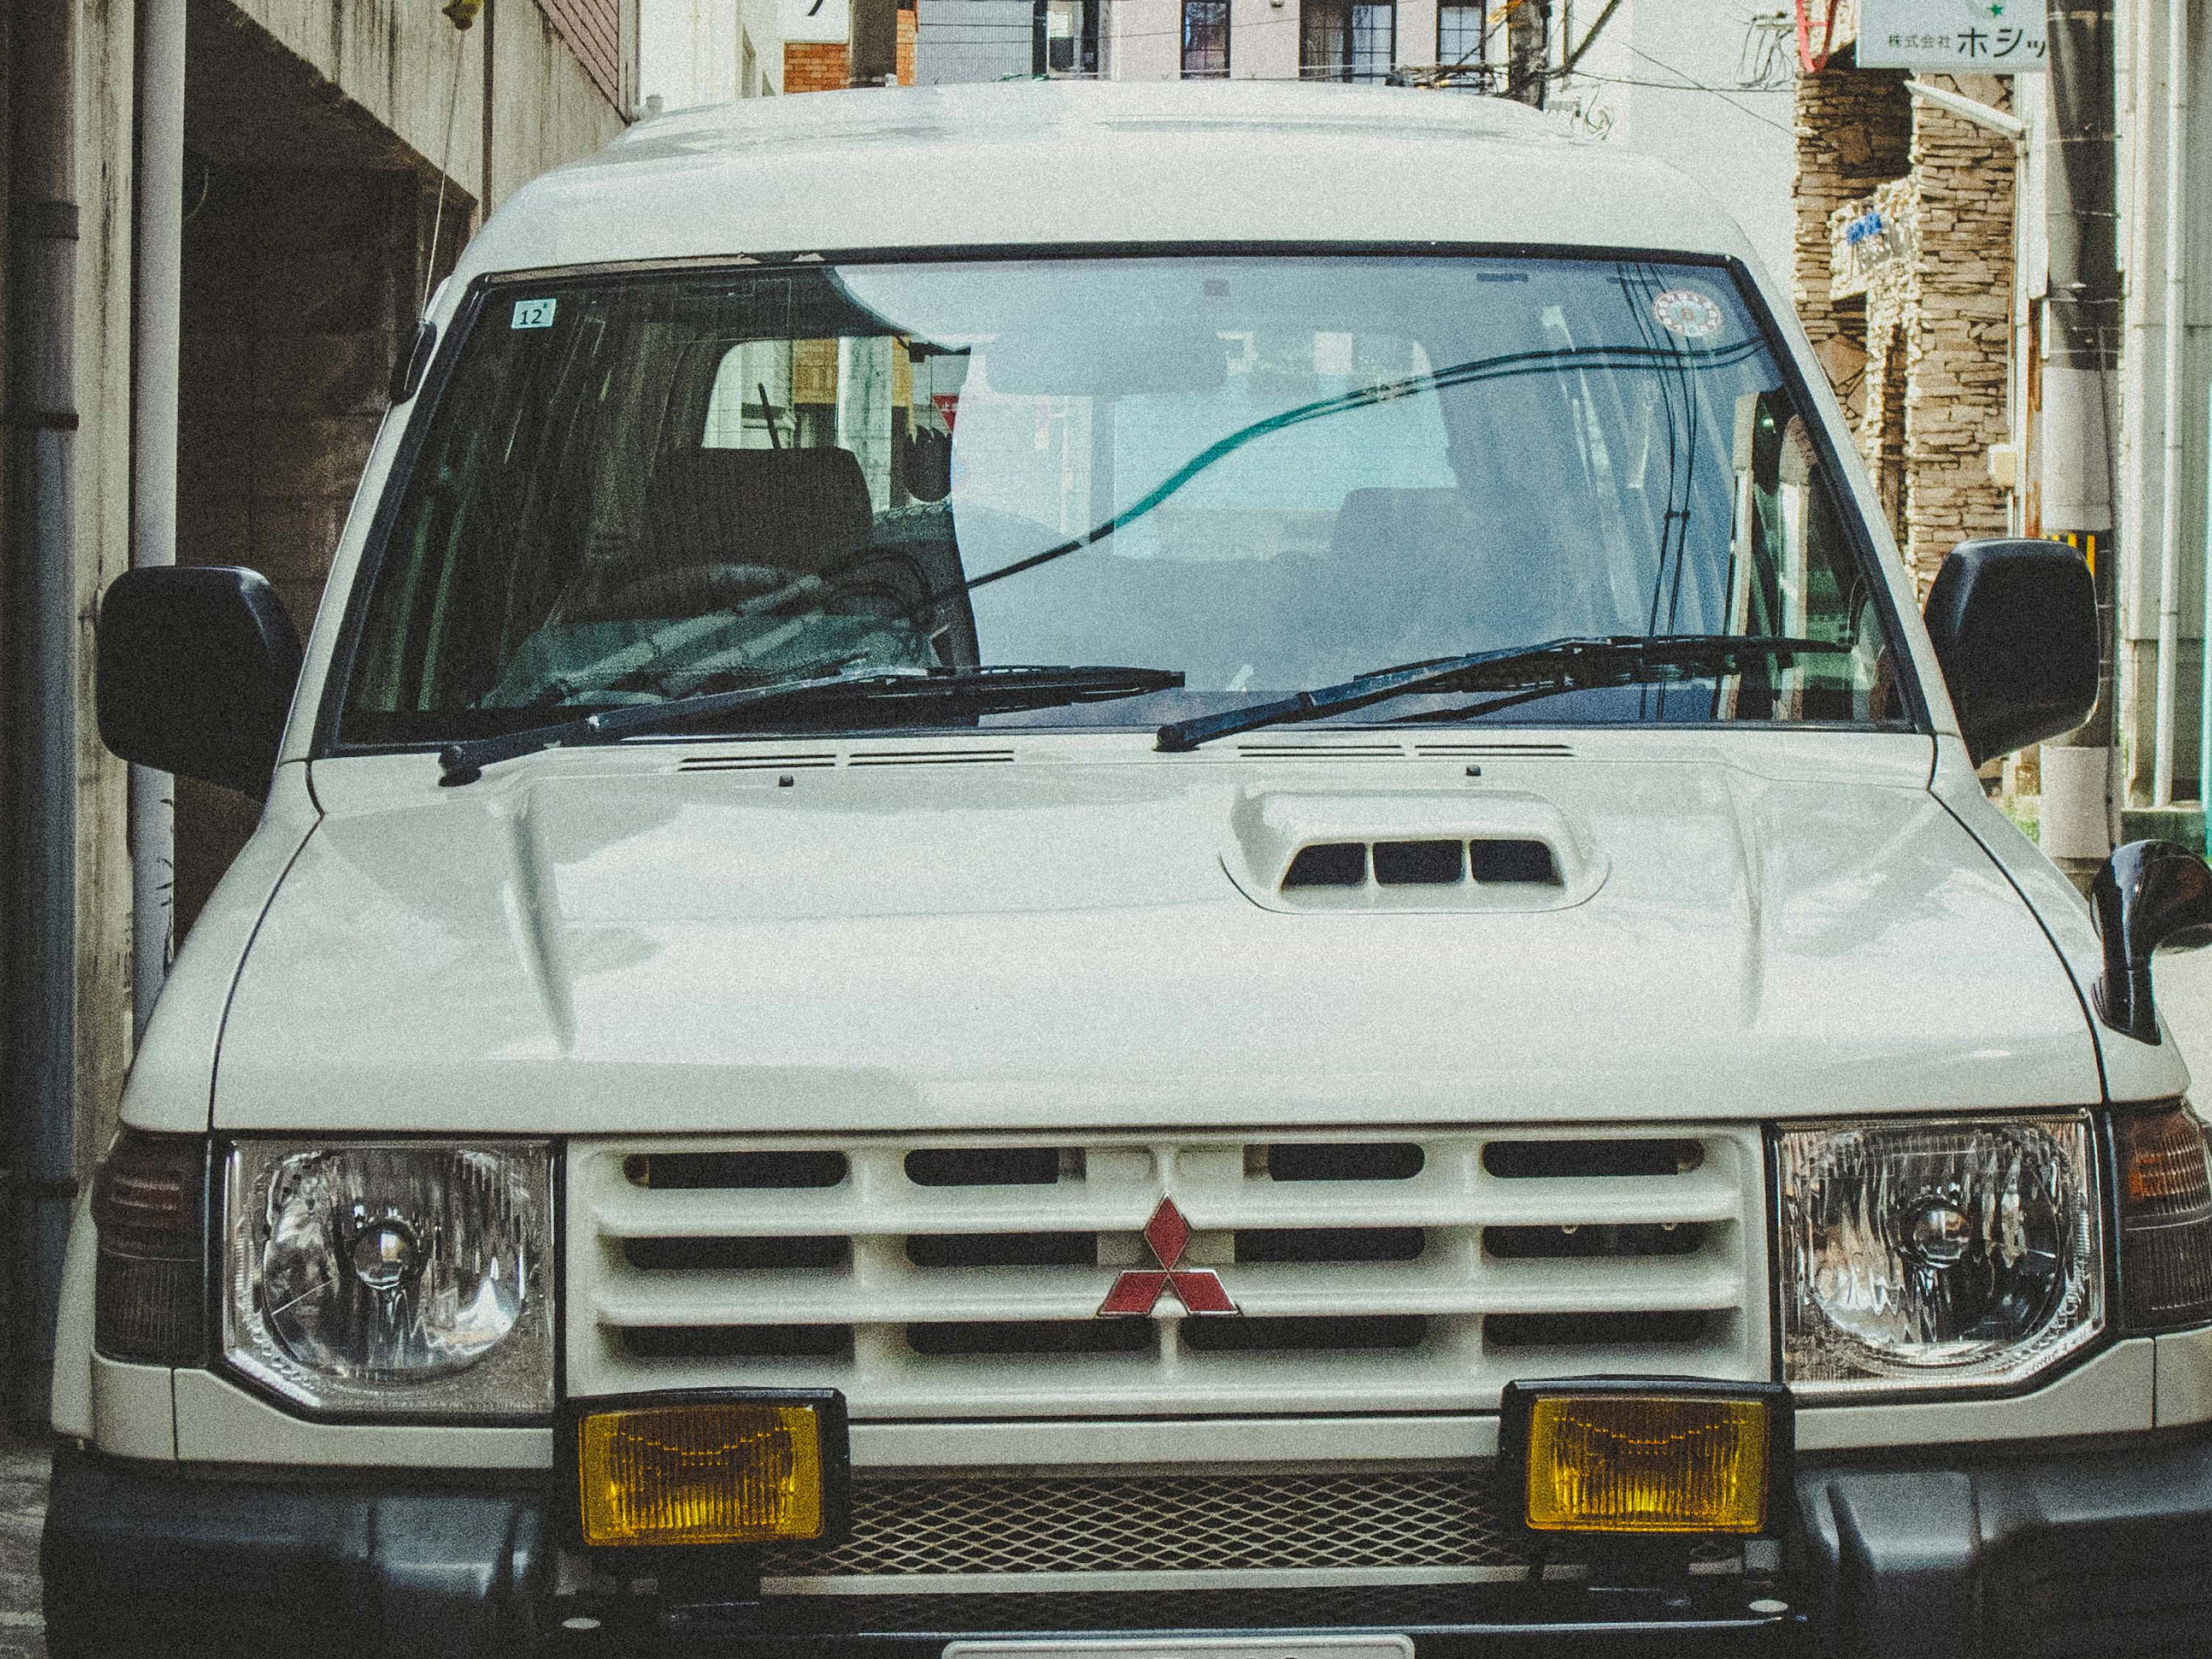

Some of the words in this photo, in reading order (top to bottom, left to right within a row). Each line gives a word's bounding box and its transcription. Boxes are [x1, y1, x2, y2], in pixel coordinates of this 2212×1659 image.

[1888, 35, 1951, 48] 株式会社
[519, 309, 543, 325] 12
